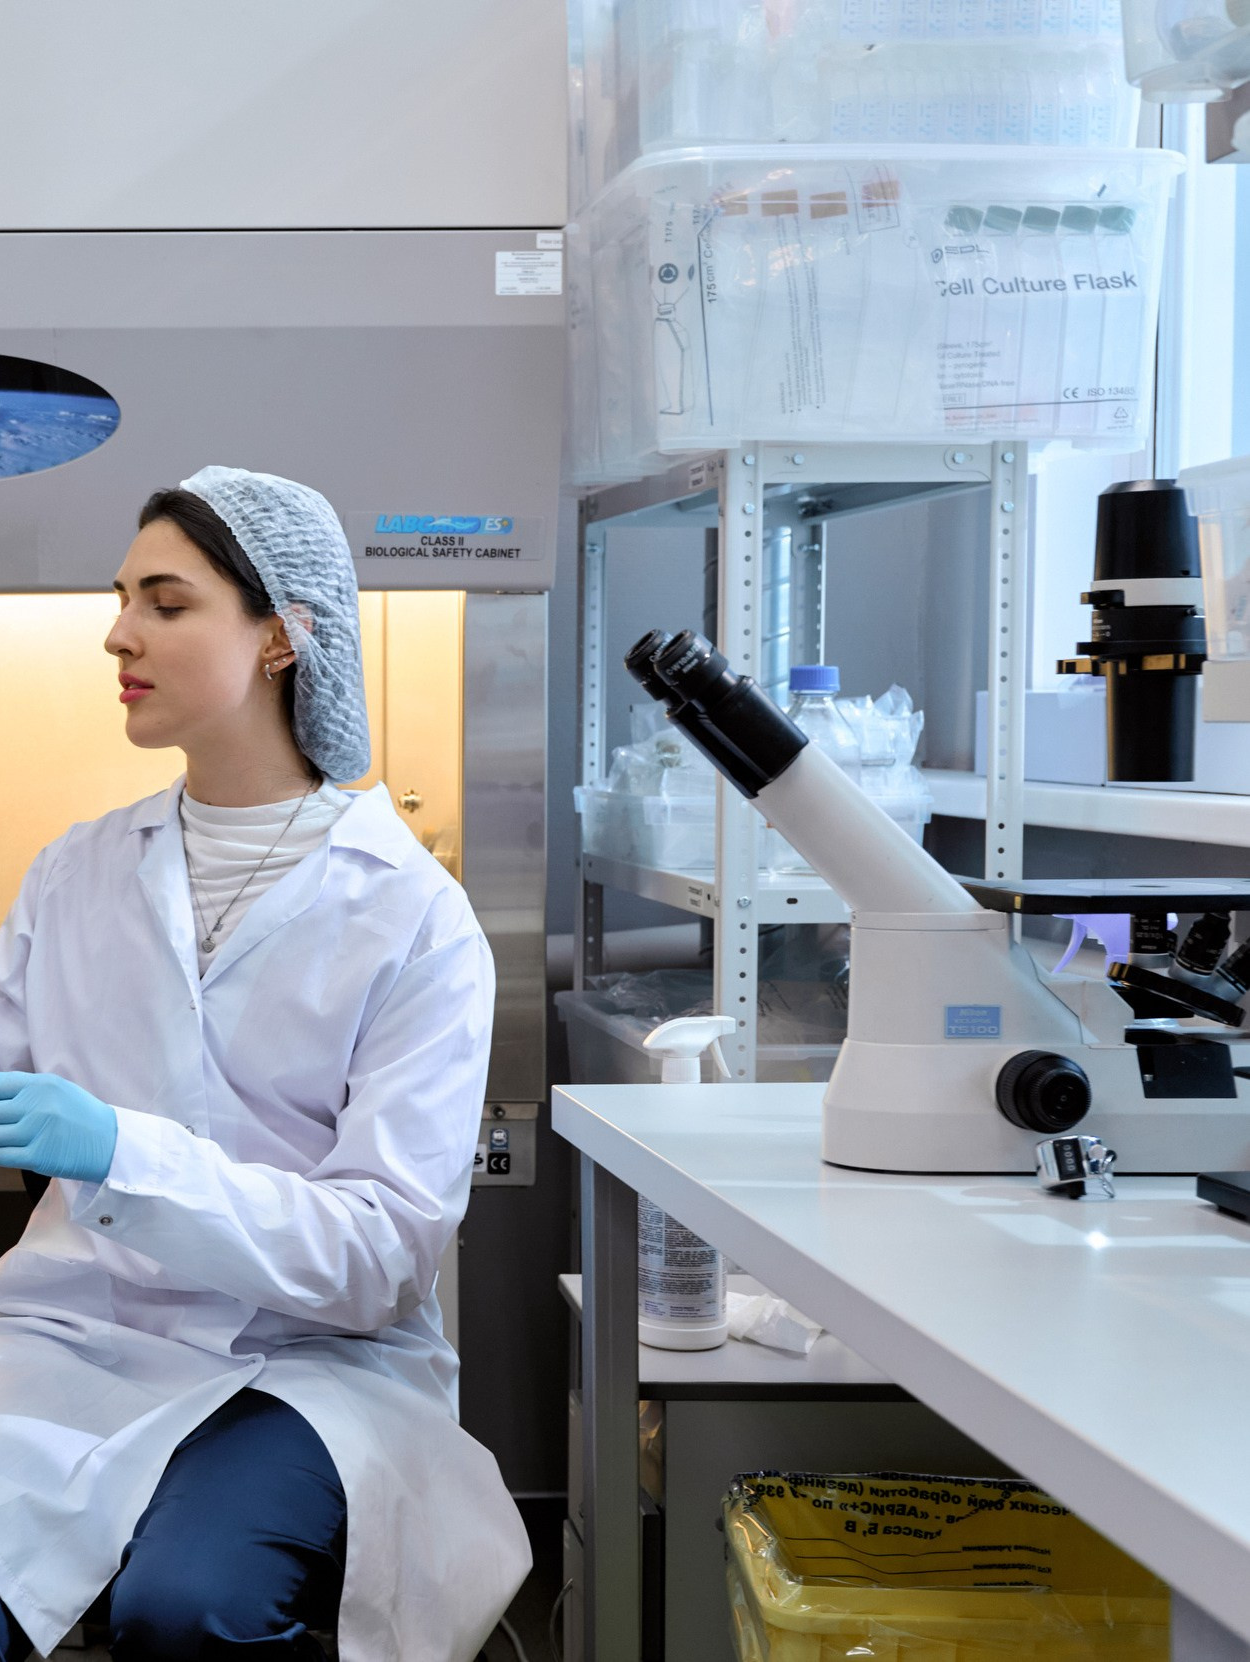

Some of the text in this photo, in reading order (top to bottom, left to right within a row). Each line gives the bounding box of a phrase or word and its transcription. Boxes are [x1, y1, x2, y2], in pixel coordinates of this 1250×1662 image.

[982, 277, 1067, 295] Culture
[1073, 271, 1138, 291] Flask
[1087, 387, 1105, 397] ISO
[420, 536, 465, 546] CLASS II
[365, 547, 521, 559] BIOLOGICAL SAFETY CABINET
[948, 1025, 999, 1034] TS100
